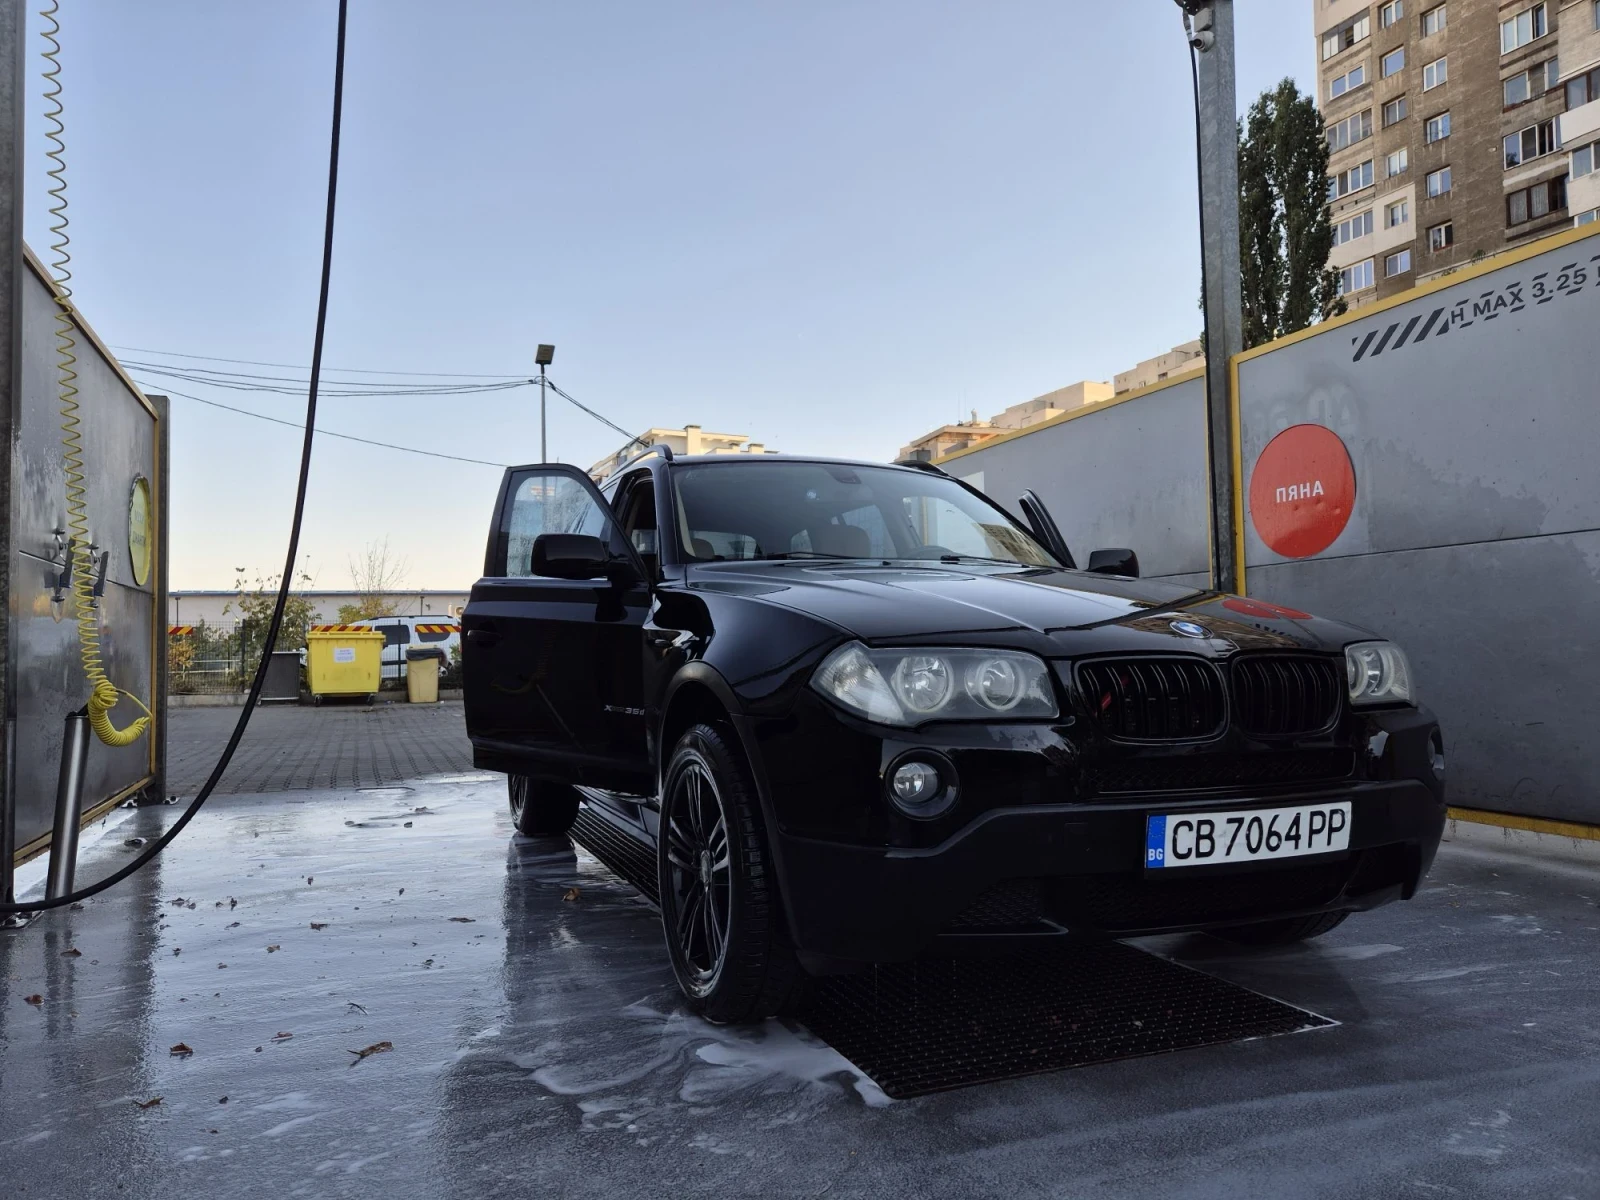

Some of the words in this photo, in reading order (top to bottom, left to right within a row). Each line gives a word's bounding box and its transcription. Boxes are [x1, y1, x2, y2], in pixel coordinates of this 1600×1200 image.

[1450, 307, 1464, 324] H
[1473, 287, 1523, 318] MAX
[1532, 267, 1588, 298] 3.25
[1276, 480, 1324, 504] ПЯНА
[1148, 849, 1164, 861] BG
